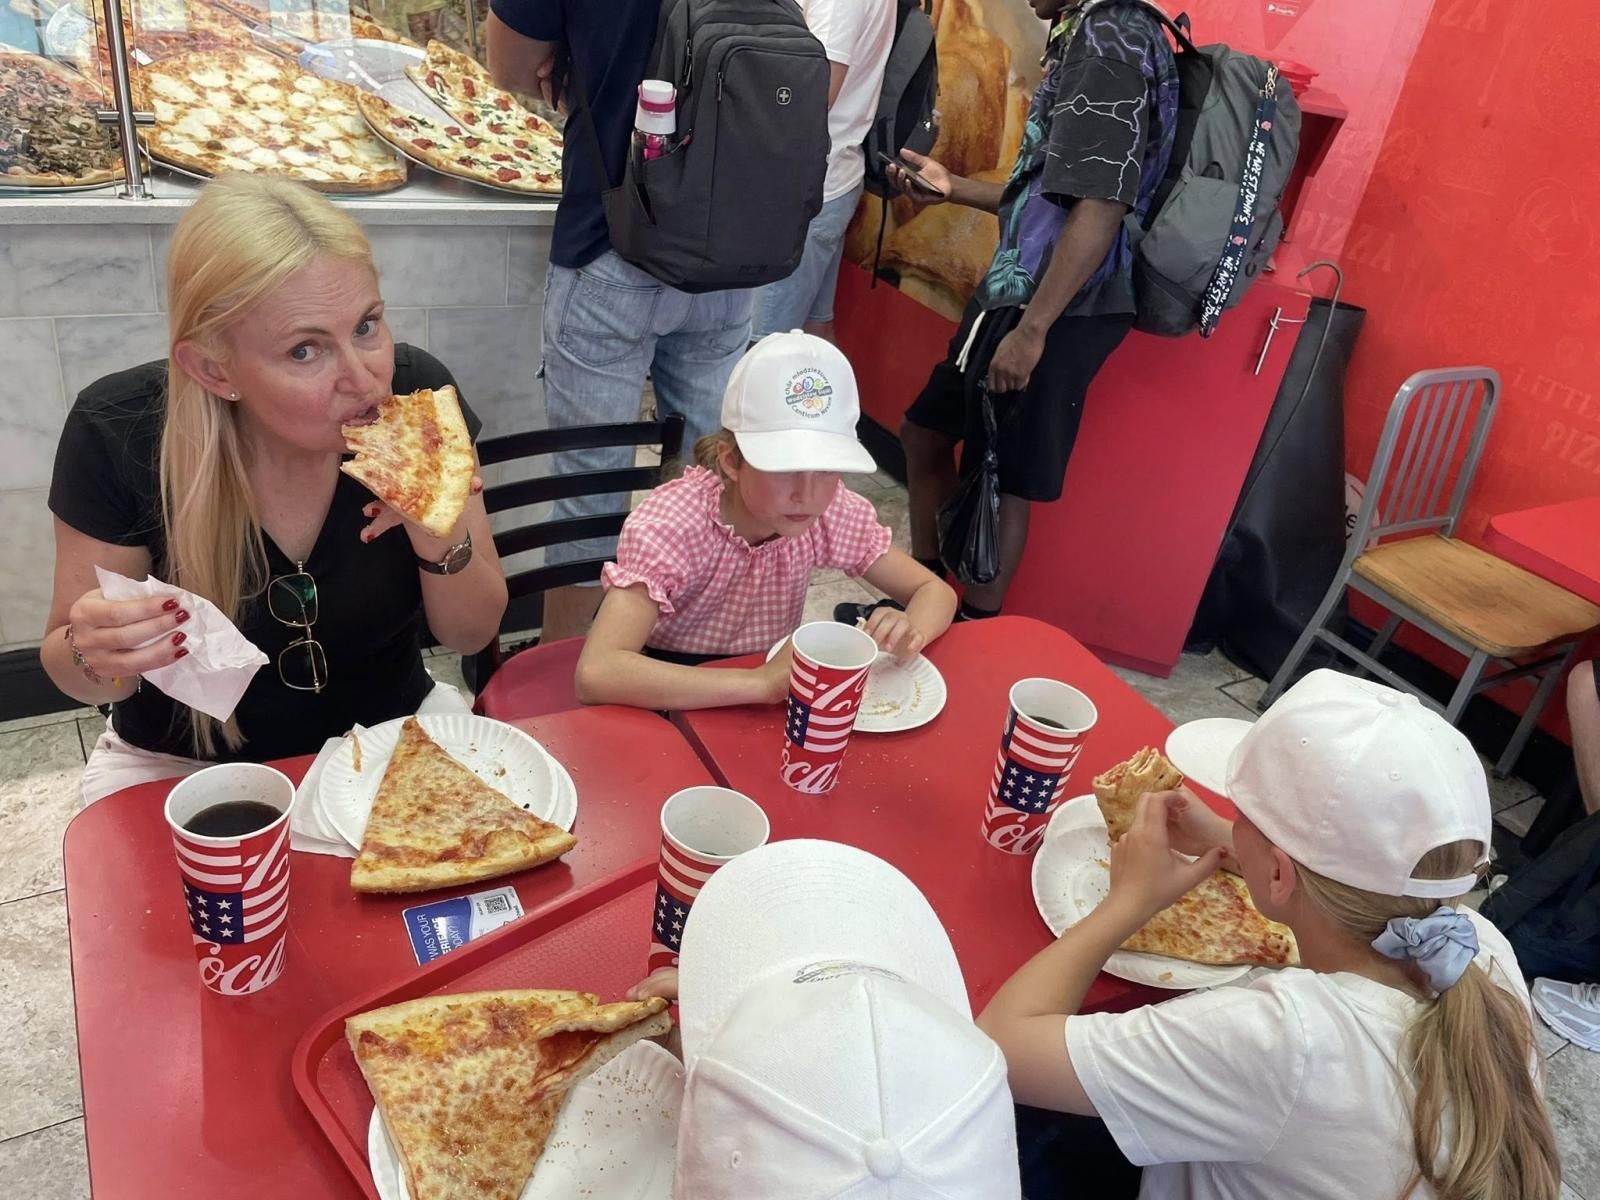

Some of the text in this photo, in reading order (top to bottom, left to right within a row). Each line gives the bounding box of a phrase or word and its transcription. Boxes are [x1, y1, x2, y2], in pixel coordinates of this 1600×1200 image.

[1255, 141, 1265, 158] WE
[1250, 156, 1263, 176] ARE
[1247, 175, 1259, 192] ST
[1223, 256, 1234, 271] WE
[1216, 270, 1230, 290] ARE
[1210, 286, 1222, 305] ST
[416, 913, 439, 958] WAS YOUR
[431, 917, 452, 955] ERIENCE
